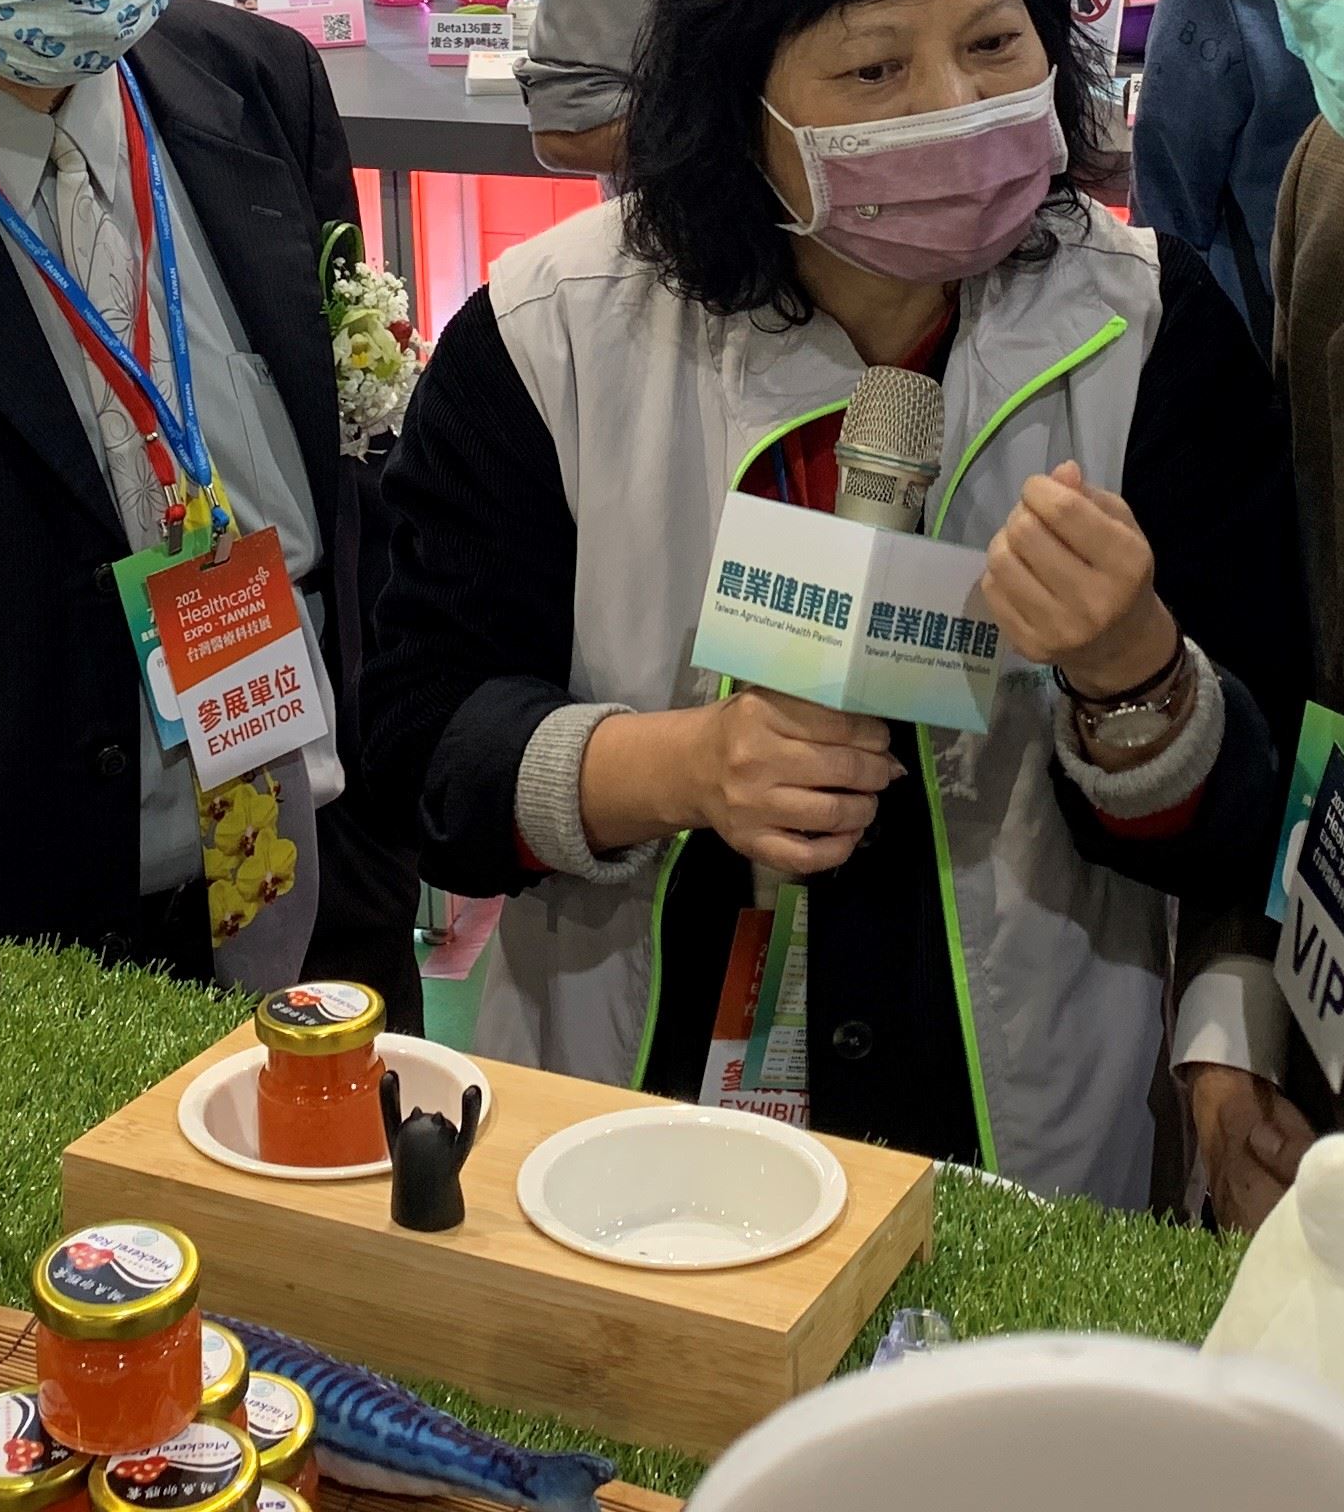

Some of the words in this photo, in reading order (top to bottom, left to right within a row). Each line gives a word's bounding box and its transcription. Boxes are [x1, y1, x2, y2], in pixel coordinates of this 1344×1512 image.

[152, 154, 161, 185] TAIWAN
[42, 259, 69, 289] TAIWAN
[169, 267, 180, 300] TAIWAN
[119, 349, 143, 377] TAIWAN
[185, 383, 195, 416] TAIWAN
[175, 588, 203, 609] 2021
[178, 582, 262, 628] Healthcare
[716, 559, 854, 630] 農業健康館
[183, 623, 214, 643] EXPO
[219, 599, 267, 626] TAIWAN
[714, 601, 739, 618] Taiwan
[740, 608, 786, 632] Agricultural
[785, 621, 812, 637] Health
[812, 627, 843, 648] Pavilion
[867, 600, 1001, 660] 農業健康館
[198, 663, 302, 735] 參展單位
[207, 697, 306, 757] EXHIBITOR
[87, 1232, 112, 1248] Roe
[113, 1243, 175, 1272] Mackerel
[244, 1397, 293, 1420] Macker
[156, 1440, 230, 1458] Mackerel
